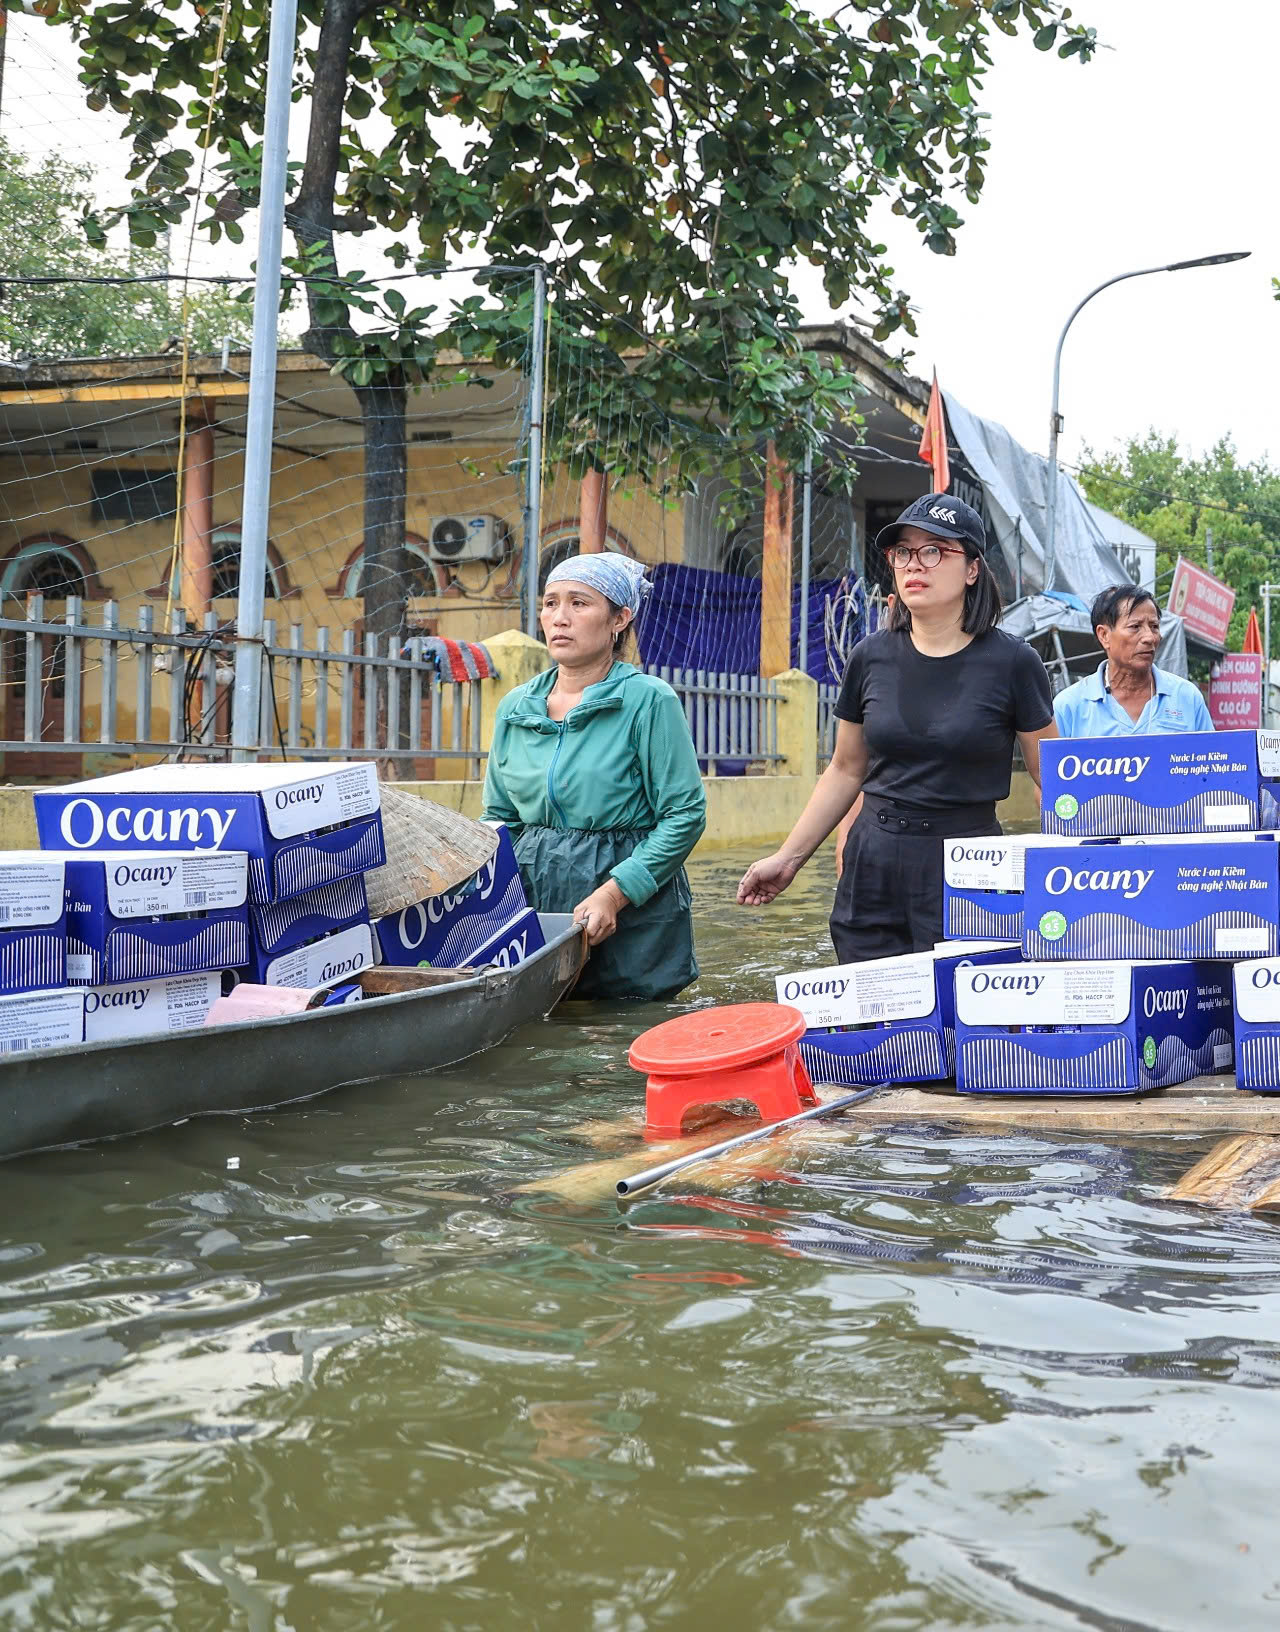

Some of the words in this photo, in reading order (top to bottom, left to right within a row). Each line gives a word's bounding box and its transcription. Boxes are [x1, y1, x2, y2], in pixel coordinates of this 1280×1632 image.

[1218, 701, 1234, 715] CAO
[1259, 734, 1280, 754] Ocany
[1057, 754, 1151, 783] Ocany
[1169, 753, 1189, 763] Nước
[1169, 766, 1189, 776] công
[1190, 765, 1210, 775] nghệ
[1210, 763, 1231, 774] Nhật
[1231, 762, 1248, 772] Bản
[274, 783, 325, 811] Ocany
[60, 797, 238, 850] Ocany
[951, 845, 1007, 867] Ocany
[113, 863, 178, 887] Ocany
[1044, 865, 1155, 899] Ocany
[1176, 867, 1201, 877] Nước
[1221, 866, 1246, 877] Kiềm
[1176, 881, 1199, 892] công
[1200, 880, 1223, 892] nghệ
[1224, 879, 1248, 891] Nhật
[1248, 879, 1268, 889] Bản
[74, 902, 92, 913] Bản
[118, 905, 130, 915] 8,4
[130, 905, 135, 914] L
[146, 902, 161, 913] 350
[162, 902, 169, 911] ml
[318, 952, 364, 983] Ocany
[784, 978, 850, 1001] Ocany
[971, 972, 1045, 996] Ocany
[84, 986, 151, 1013] Ocany
[1143, 986, 1189, 1020] Ocany
[818, 1016, 832, 1024] 350
